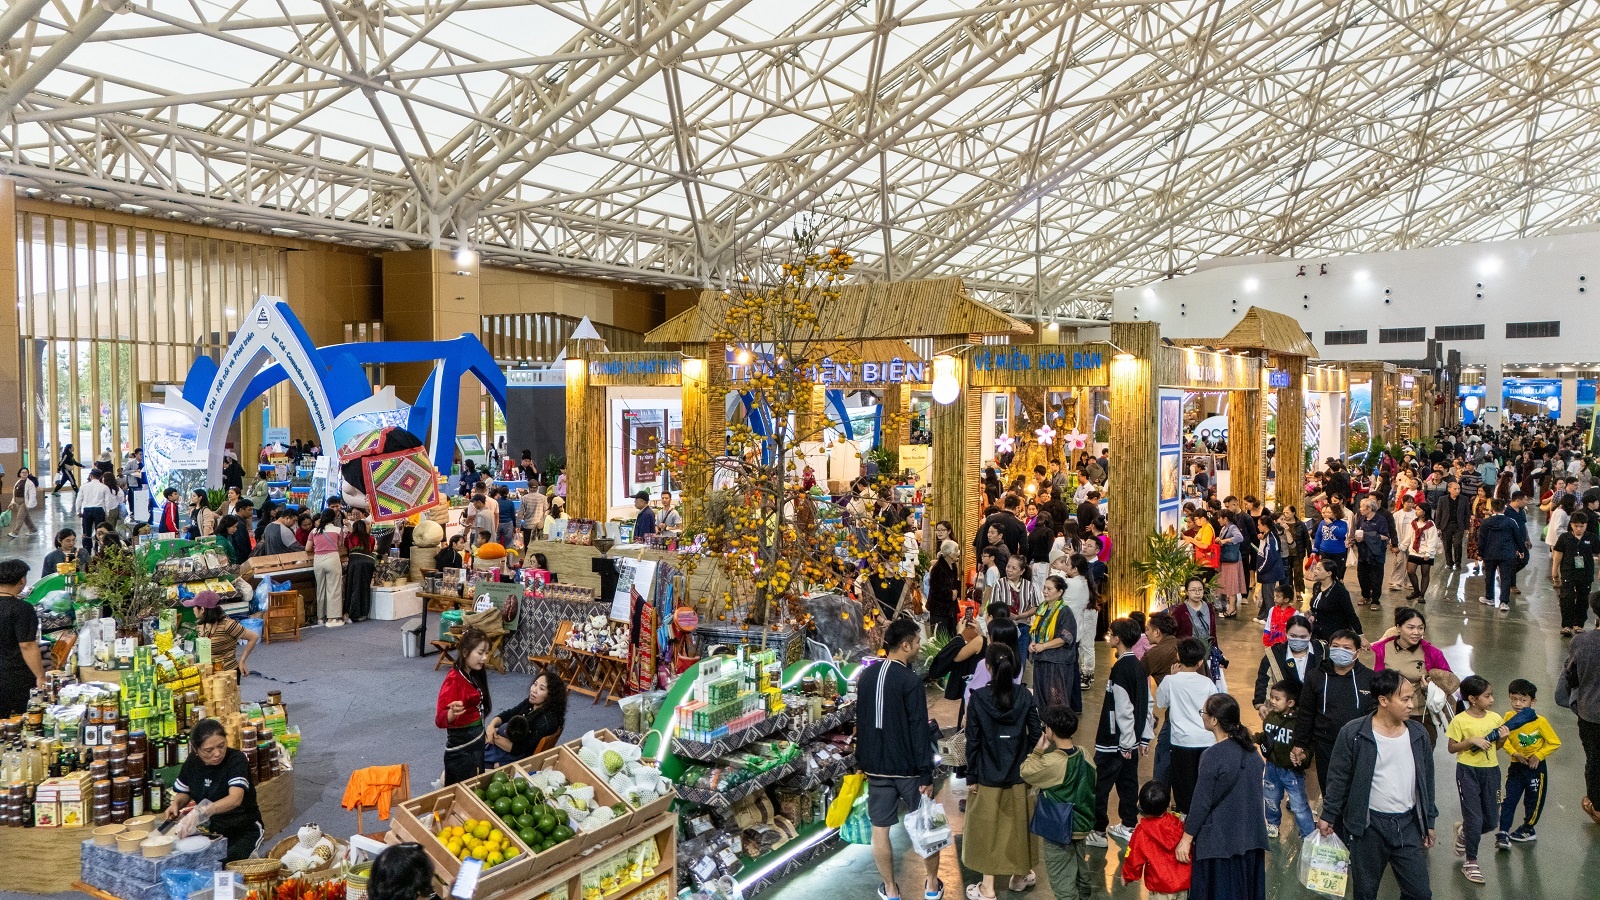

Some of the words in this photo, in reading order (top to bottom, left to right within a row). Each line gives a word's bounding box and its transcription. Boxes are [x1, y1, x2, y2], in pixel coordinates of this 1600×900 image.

[975, 347, 992, 371] VỀ
[995, 346, 1031, 371] MIỀN
[1038, 352, 1067, 370] HOA
[1073, 351, 1103, 370] BAN
[794, 357, 853, 387] IỆN
[862, 356, 924, 383] BIÊN
[209, 397, 217, 410] Cai
[286, 351, 305, 382] Connection
[303, 380, 311, 392] and
[308, 390, 326, 431] Development
[1264, 722, 1293, 744] SRF
